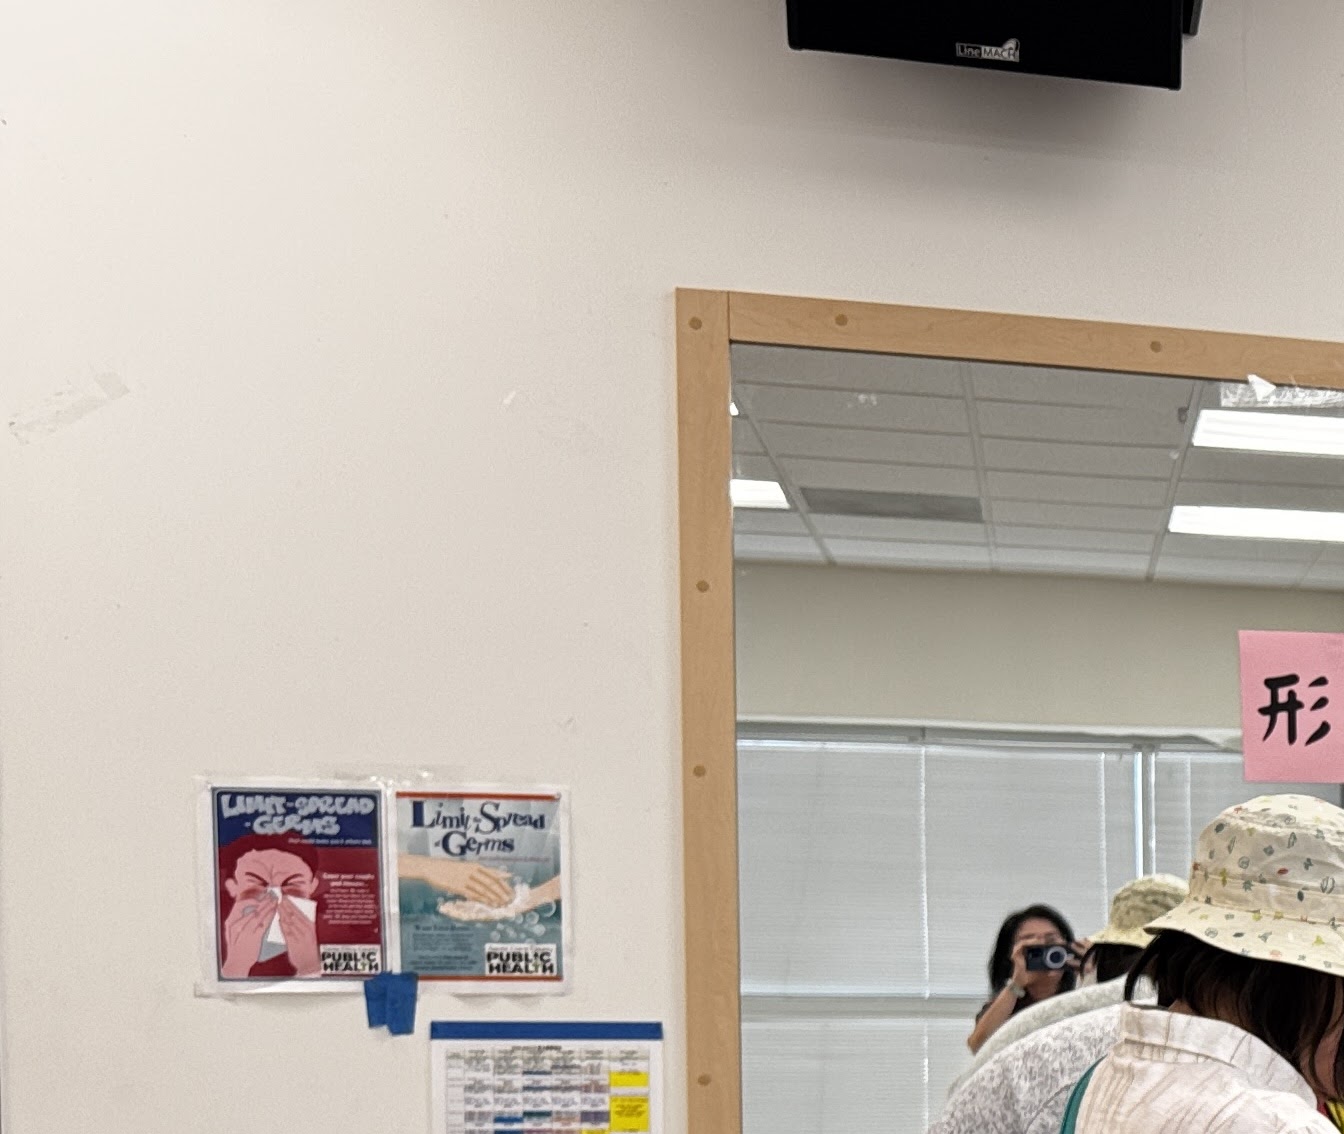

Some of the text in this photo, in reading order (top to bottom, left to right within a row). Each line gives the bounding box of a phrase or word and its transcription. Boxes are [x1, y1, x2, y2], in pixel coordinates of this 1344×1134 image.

[411, 800, 546, 835] Limit Spread
[442, 830, 515, 857] Germs
[321, 951, 377, 962] PUBLIC
[487, 951, 551, 962] PUBLIC
[323, 961, 379, 971] HEALTH
[489, 962, 554, 973] HEALTH
